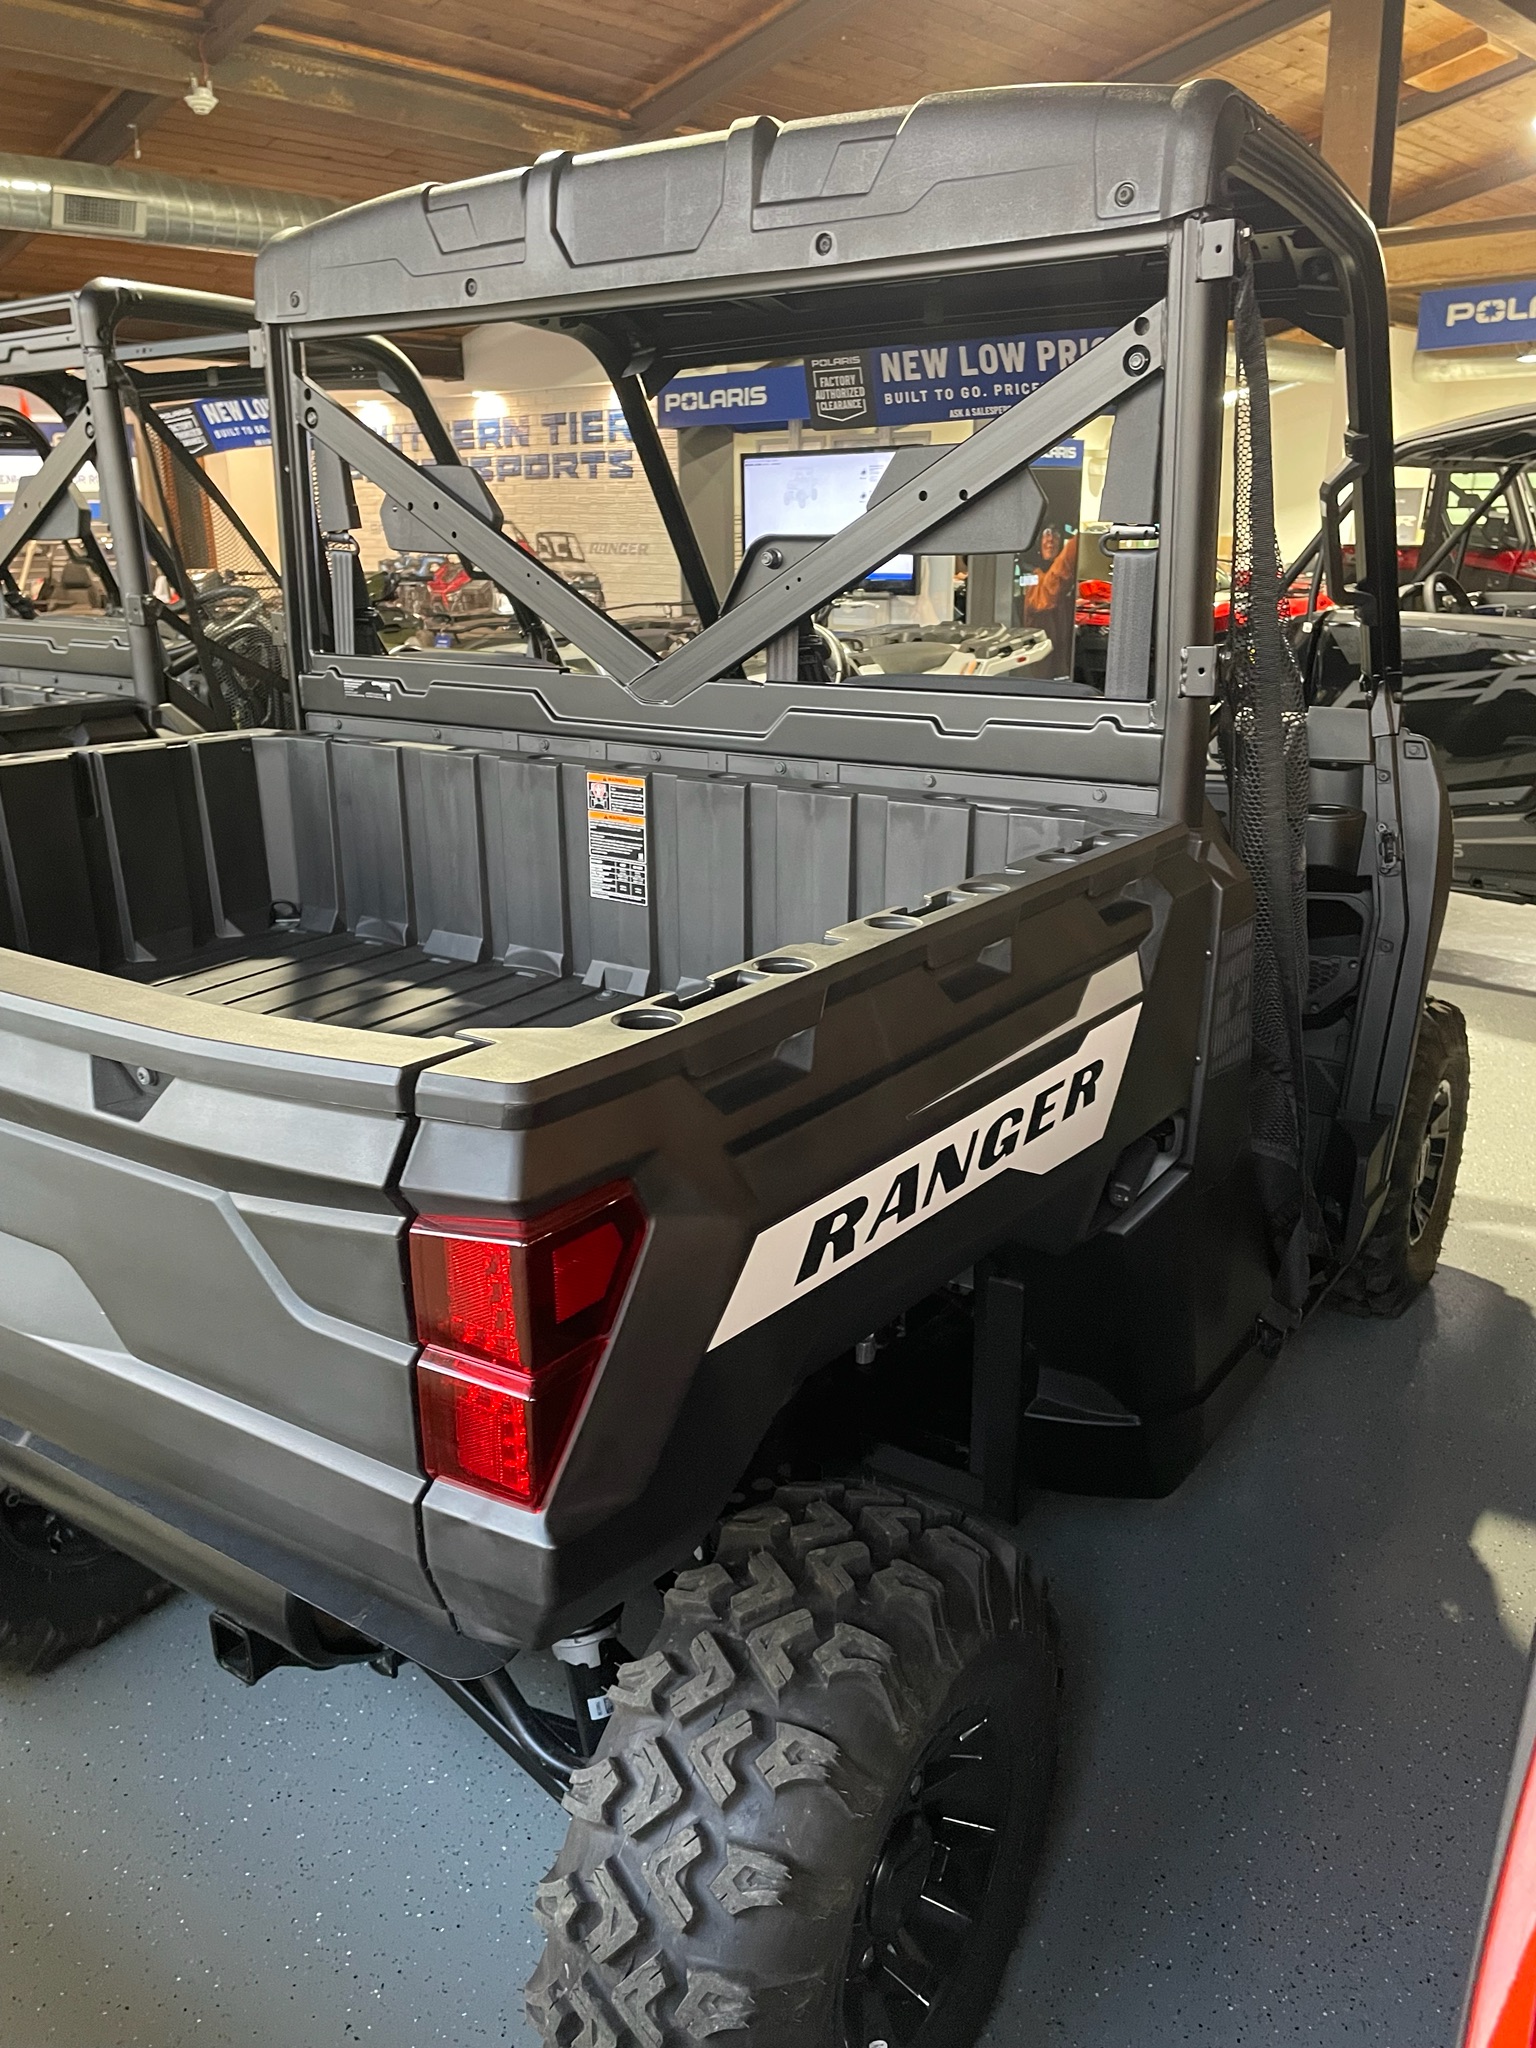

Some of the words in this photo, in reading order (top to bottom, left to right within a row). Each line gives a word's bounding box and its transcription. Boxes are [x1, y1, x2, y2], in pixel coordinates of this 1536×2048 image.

[1446, 297, 1536, 327] POL
[811, 355, 861, 368] POLARIS
[880, 348, 948, 383] NEW
[958, 341, 1026, 377] LOW
[1036, 337, 1106, 372] PRI
[815, 386, 866, 400] AUTHORIZED
[819, 374, 856, 387] FACTORY
[665, 385, 768, 412] POLARIS
[820, 399, 863, 411] CLEARANCE
[884, 390, 928, 405] BUILT
[934, 388, 954, 400] TO
[961, 386, 987, 399] GO.
[993, 382, 1044, 396] PRICE
[202, 400, 244, 425] NEW
[541, 408, 633, 445] TIER
[794, 1059, 1104, 1287] RANGER
